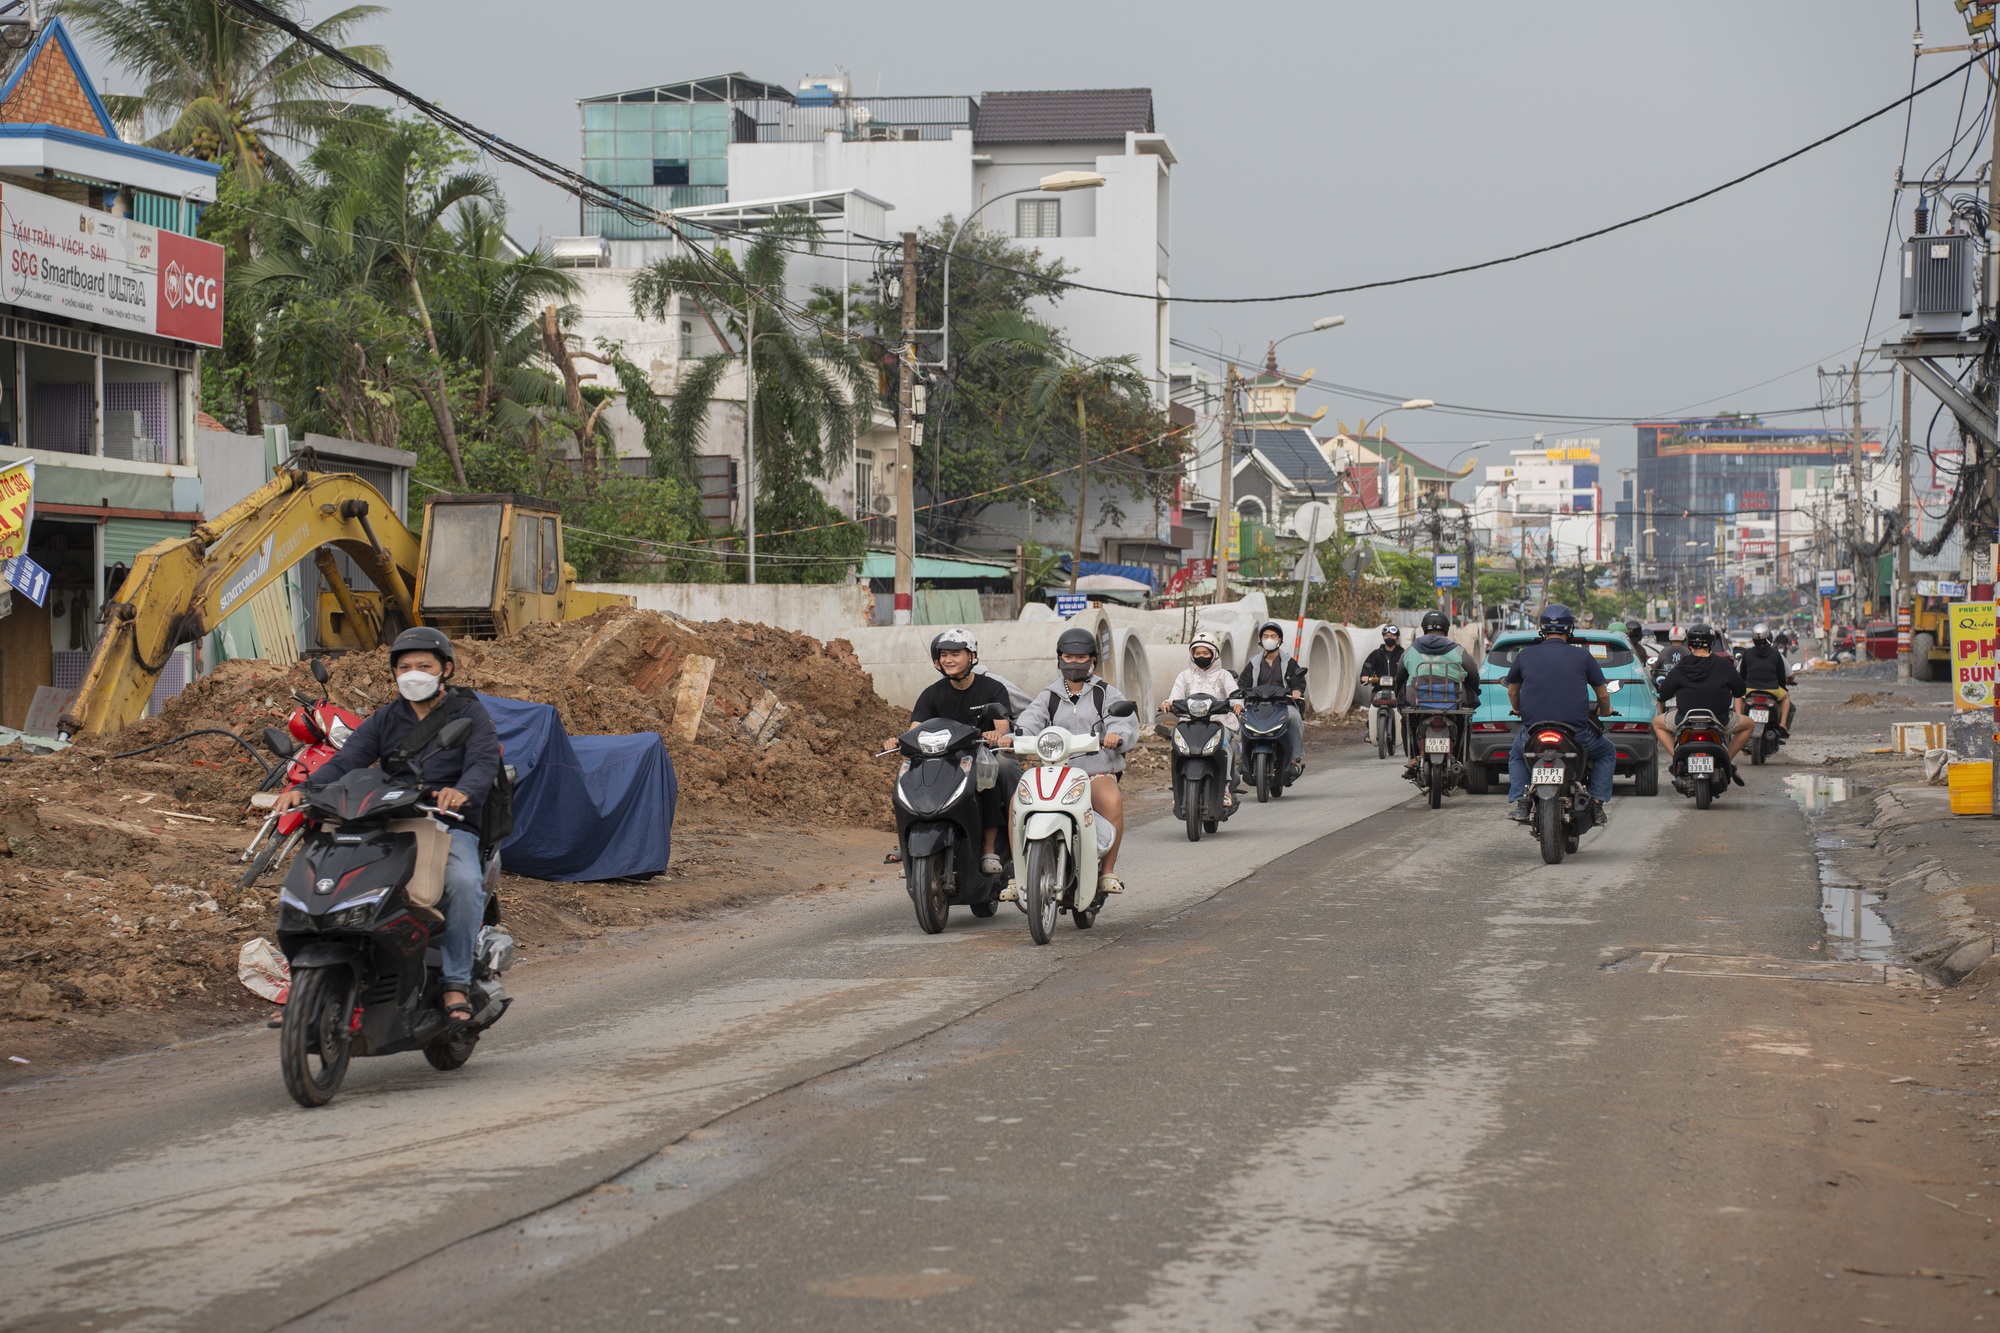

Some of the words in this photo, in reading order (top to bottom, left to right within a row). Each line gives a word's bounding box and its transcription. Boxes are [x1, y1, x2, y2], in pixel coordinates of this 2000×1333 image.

[12, 219, 30, 242] TẤM
[32, 226, 55, 249] TRẦN
[62, 234, 84, 256] VÁCH
[90, 242, 107, 262] SÀN
[12, 249, 38, 277] SCG
[41, 257, 105, 293] Smartboard
[108, 273, 146, 307] ULTRA
[184, 271, 216, 310] SCG
[10, 472, 30, 492] 393
[1744, 490, 1766, 499] NHA
[1740, 501, 1770, 510] KHOA
[220, 569, 258, 610] SUMITOMO
[1959, 618, 1994, 630] Quán
[1958, 638, 1996, 660] PH
[1960, 662, 1995, 682] BÚN
